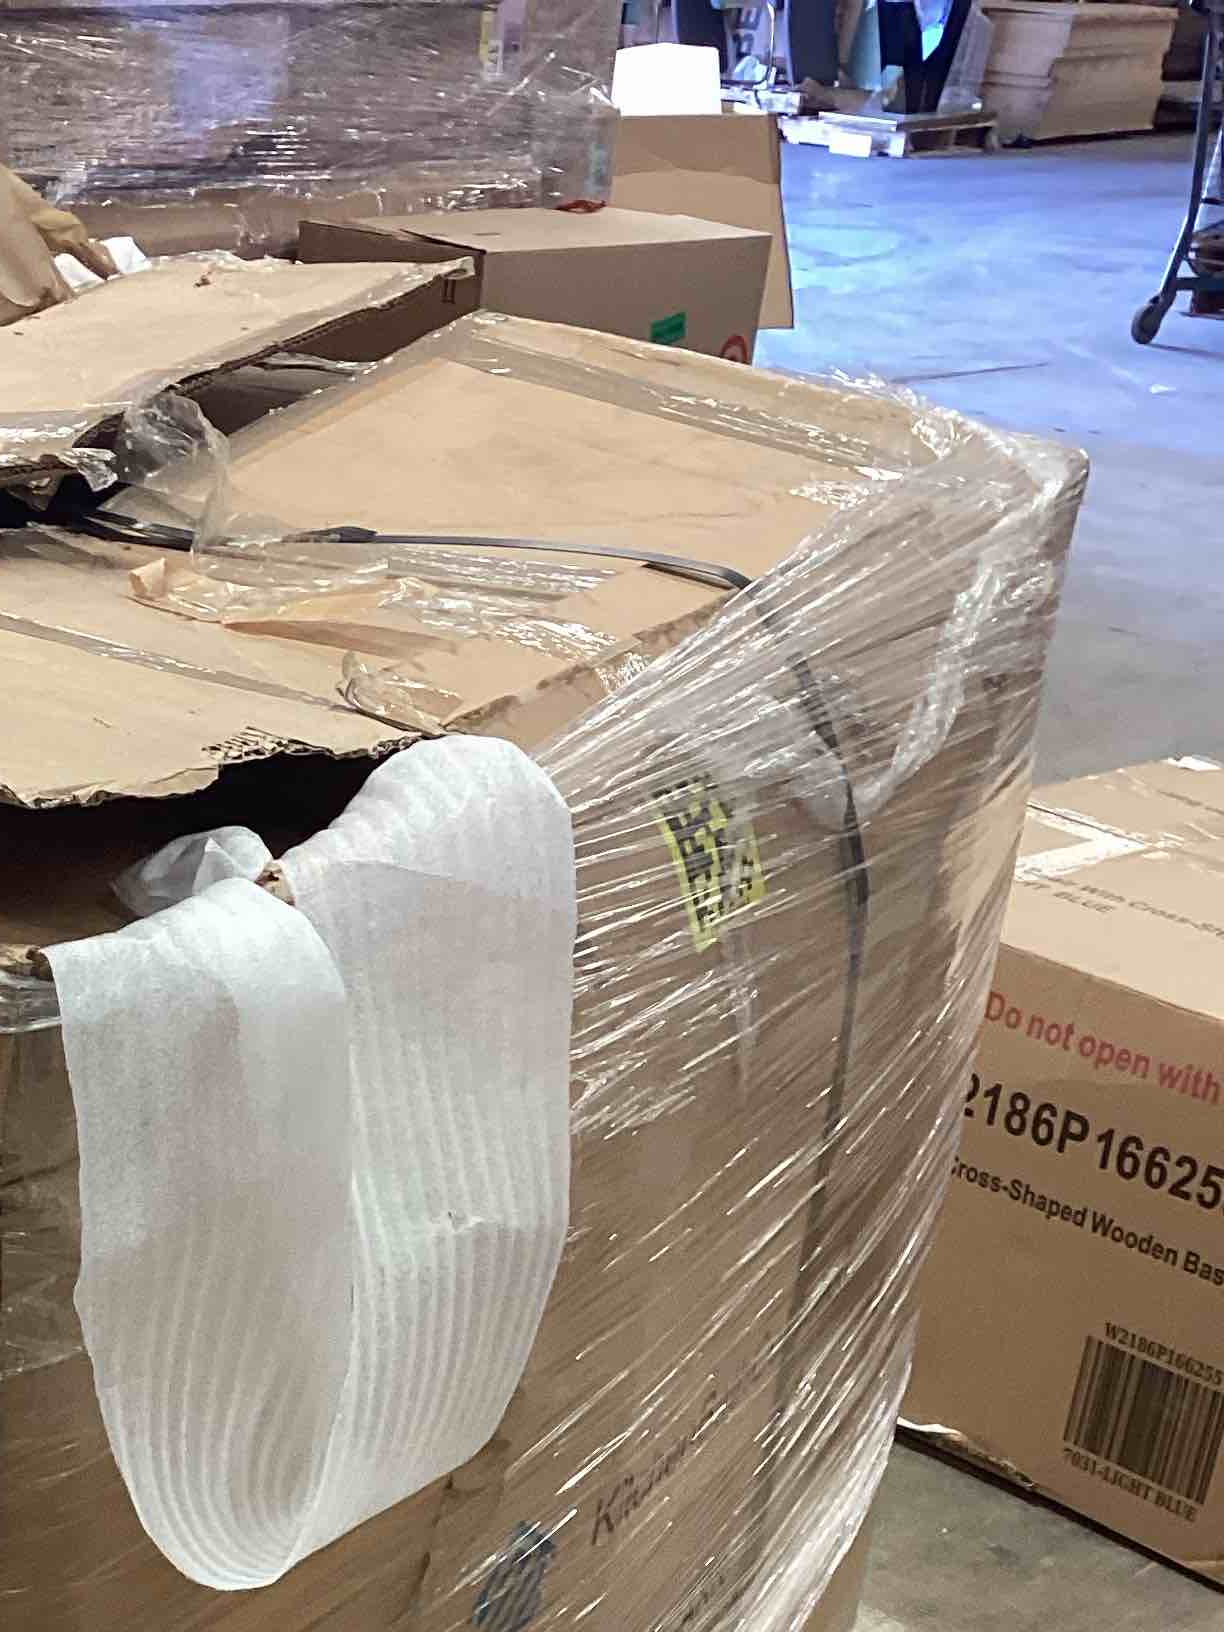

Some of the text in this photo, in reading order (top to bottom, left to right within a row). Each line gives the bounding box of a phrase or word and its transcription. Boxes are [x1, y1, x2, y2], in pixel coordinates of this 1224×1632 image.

[984, 991, 1222, 1105] Do not open with
[1090, 1211, 1179, 1267] Wooden
